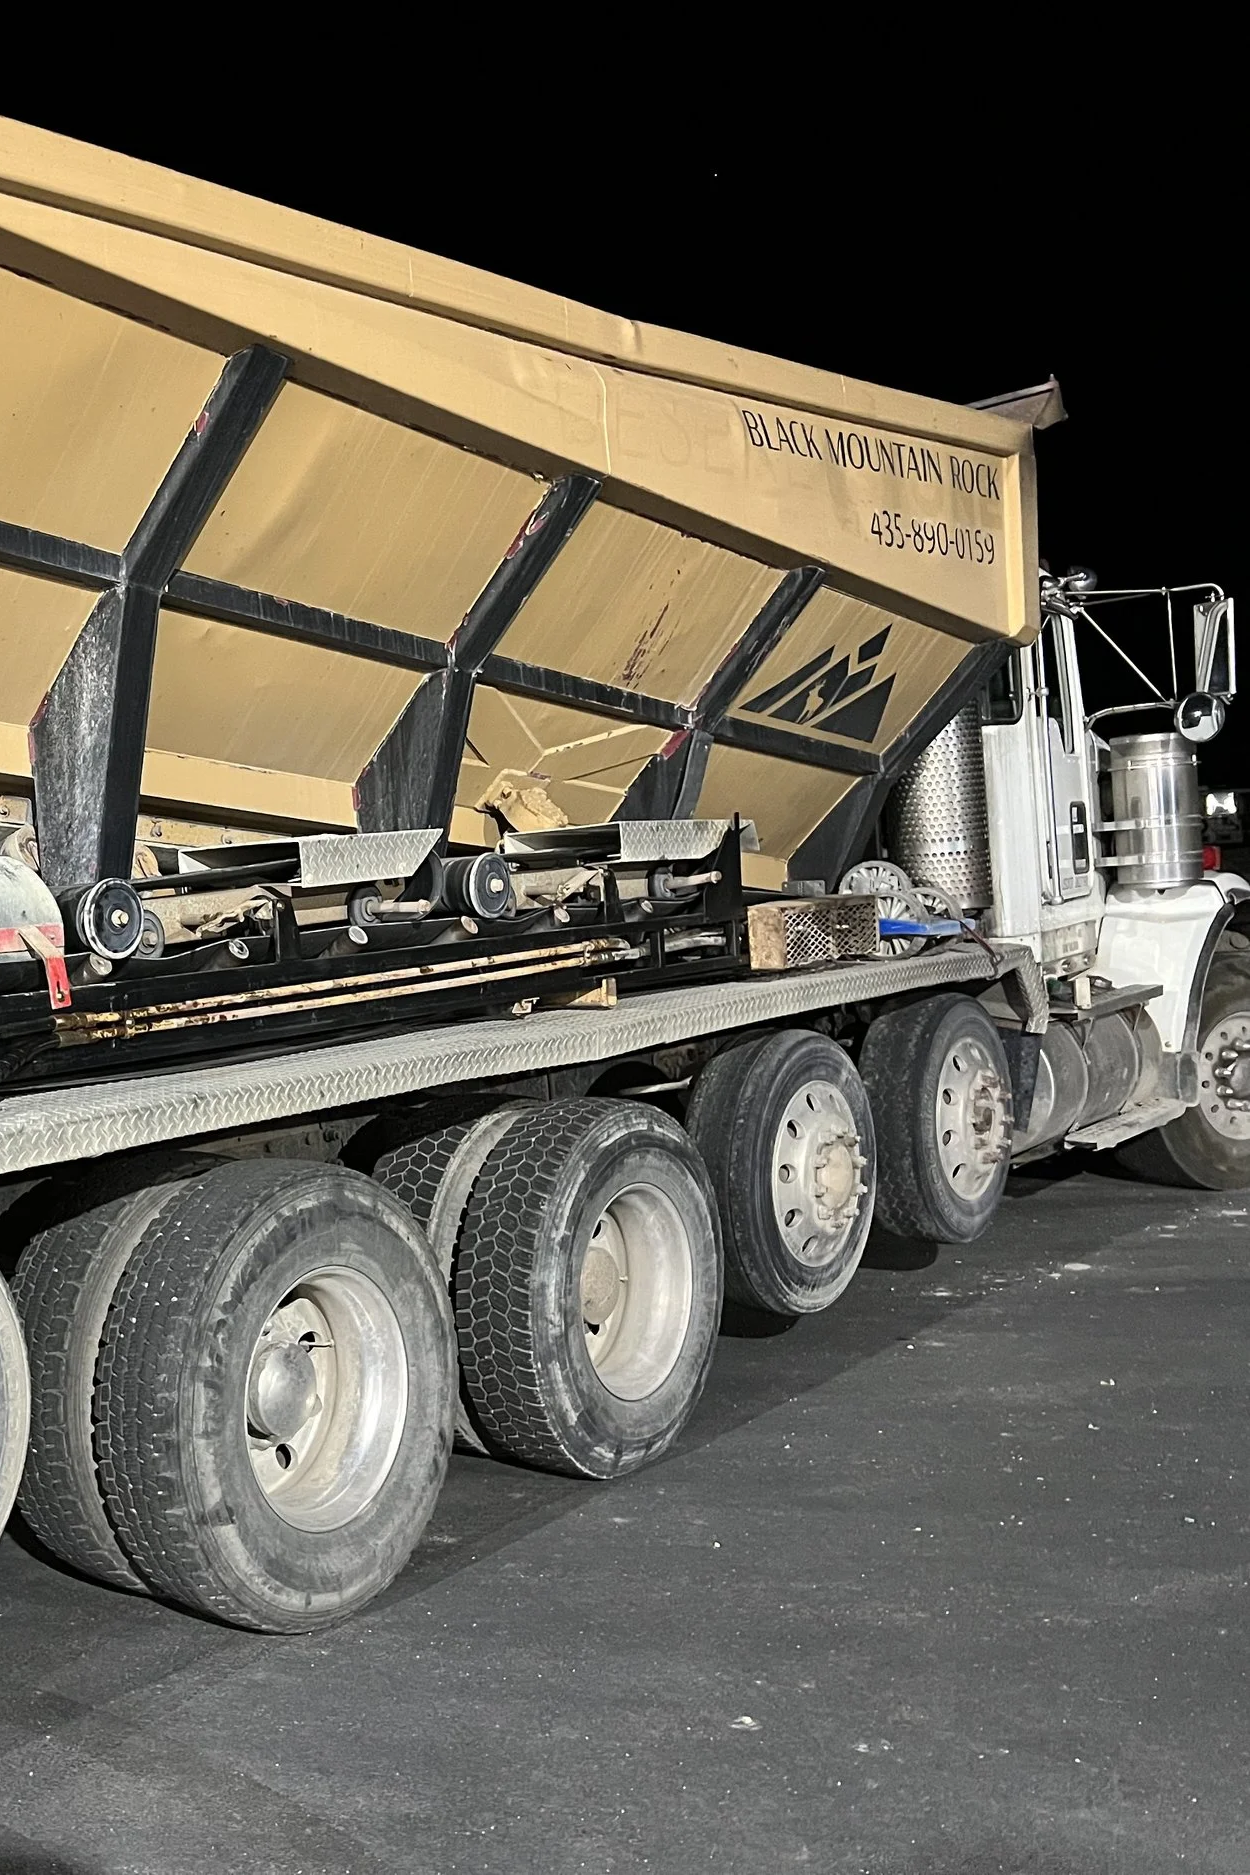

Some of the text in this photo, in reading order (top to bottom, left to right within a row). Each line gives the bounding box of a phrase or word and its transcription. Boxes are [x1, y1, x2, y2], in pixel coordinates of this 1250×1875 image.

[741, 409, 823, 461] BLACK
[824, 428, 943, 485] MOUNTAIN
[949, 455, 1000, 500] ROCK
[870, 510, 995, 565] 435-890-0159
